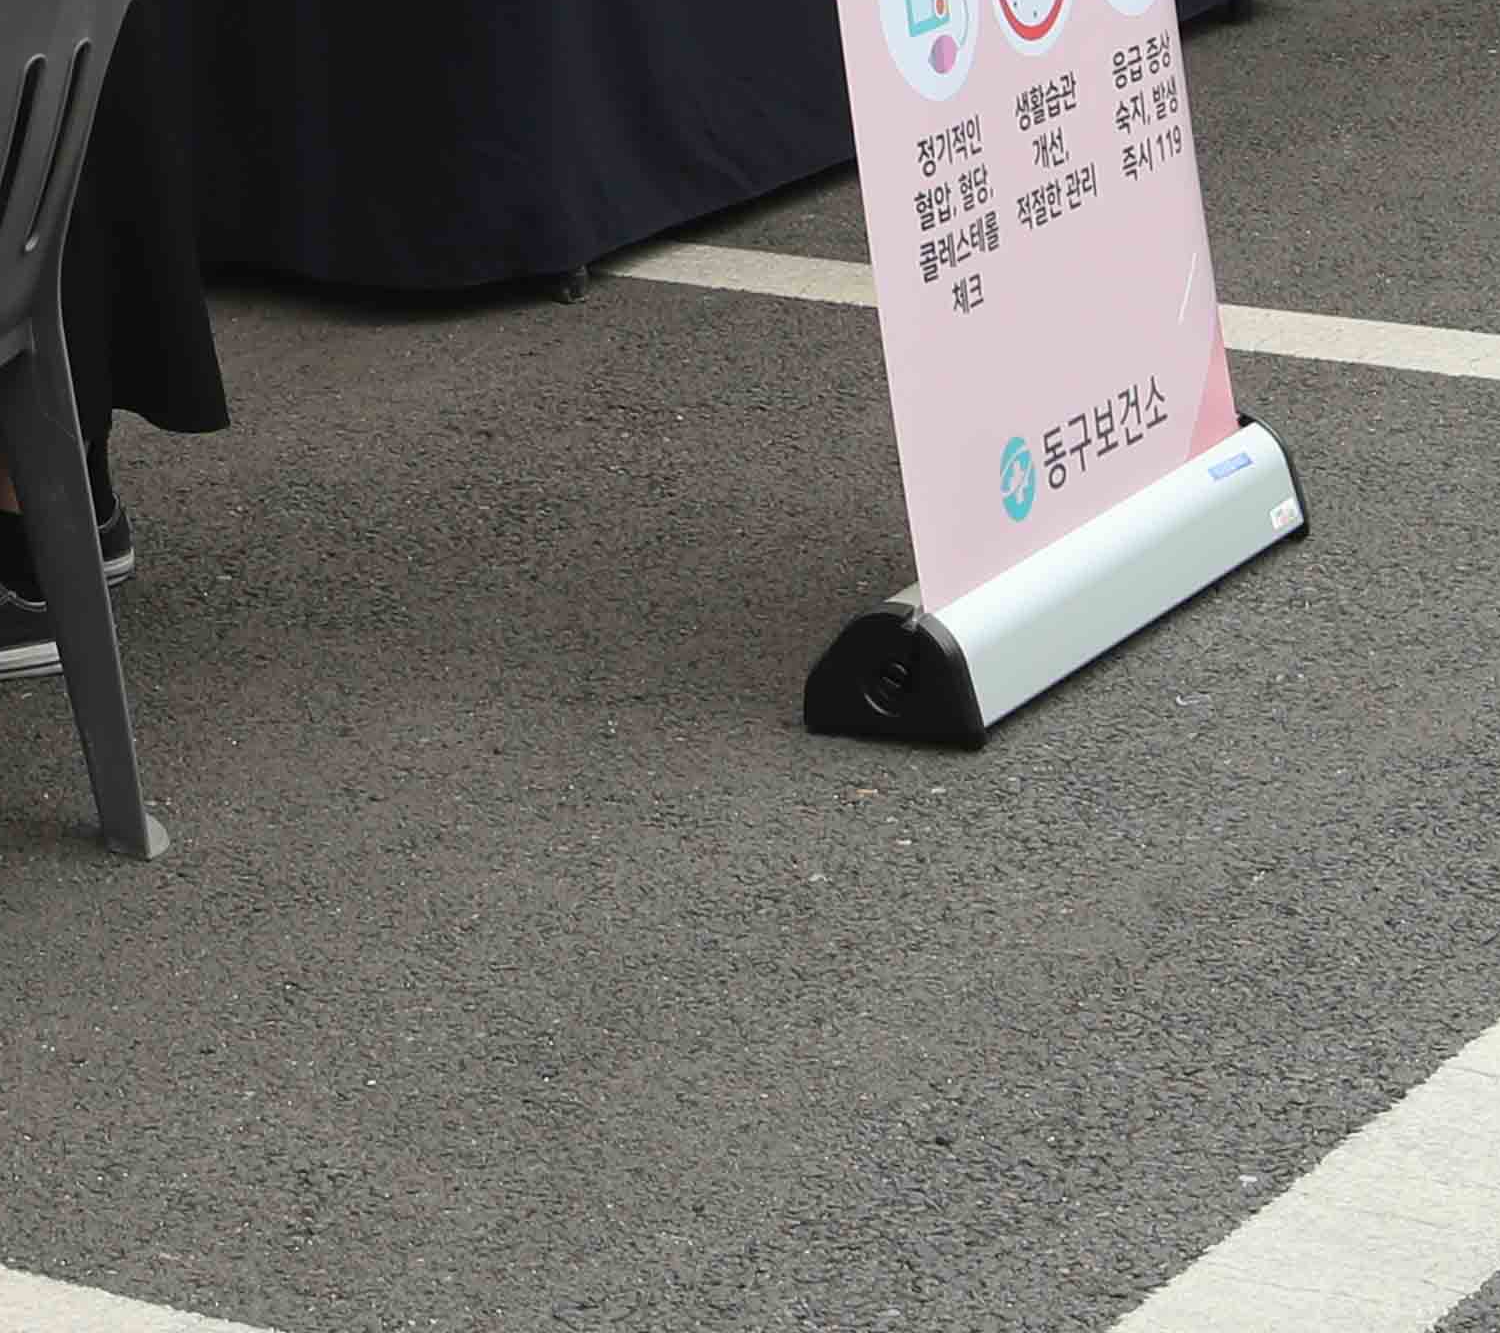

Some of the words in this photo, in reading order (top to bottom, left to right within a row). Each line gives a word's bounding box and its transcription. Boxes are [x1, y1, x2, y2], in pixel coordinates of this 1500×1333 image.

[1111, 44, 1143, 90] 응급
[1146, 29, 1172, 75] 증상
[1014, 70, 1078, 132] 생활습관
[1152, 76, 1179, 121] 발생
[916, 114, 984, 178] 정기적인
[1120, 142, 1154, 182] 즉시
[1155, 125, 1183, 162] 119
[1015, 182, 1063, 231] 적절한
[1065, 161, 1099, 209] 관리
[918, 210, 1001, 284] 콜레스테롤
[951, 273, 985, 315] 체크
[1042, 374, 1169, 491] 동구보건소
